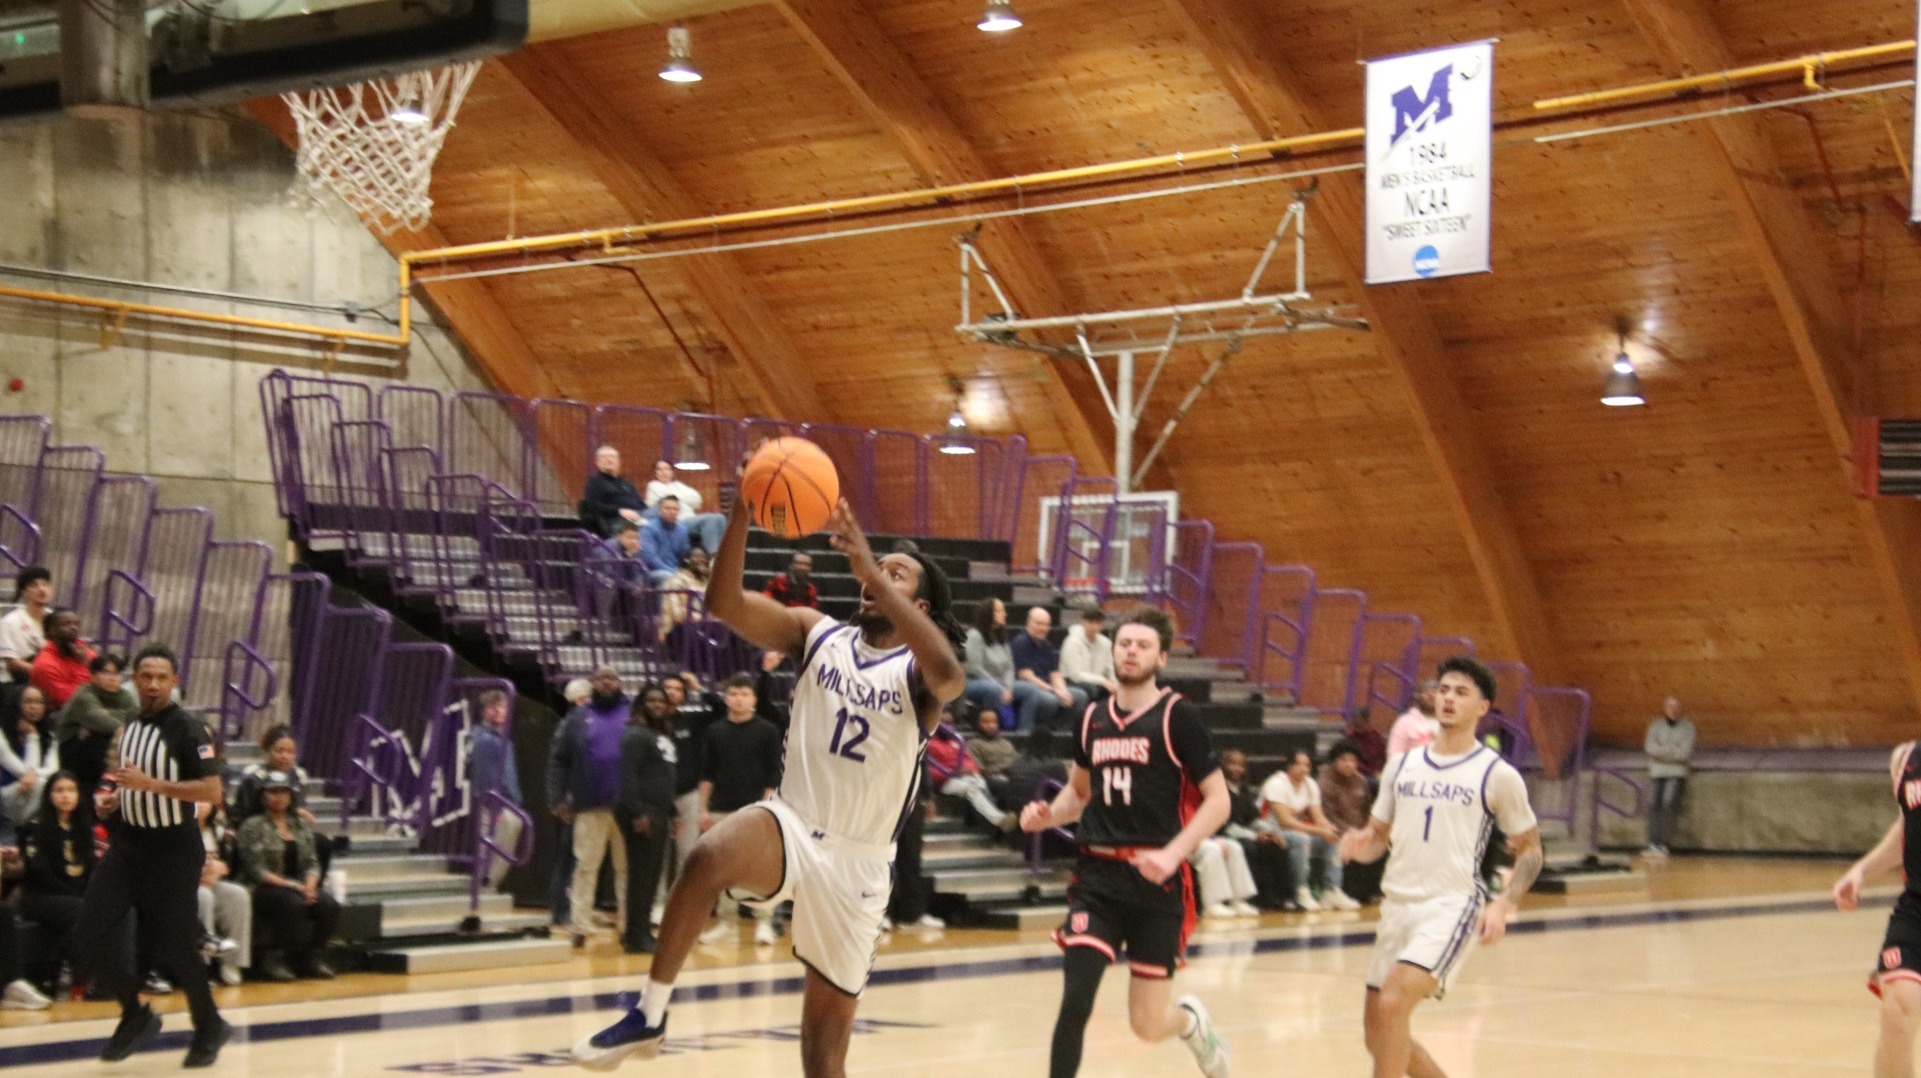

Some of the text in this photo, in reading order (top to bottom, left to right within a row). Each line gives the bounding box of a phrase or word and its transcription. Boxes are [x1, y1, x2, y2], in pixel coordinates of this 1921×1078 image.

[1410, 142, 1447, 165] 1984
[1412, 164, 1475, 185] BASKETBALL
[1405, 187, 1449, 217] NCAA
[816, 663, 903, 714] MILLSAPS
[829, 707, 870, 763] 12
[1092, 736, 1150, 766] RHODES
[1102, 767, 1132, 806] 14
[1397, 780, 1475, 807] MILLSAPS
[1422, 804, 1434, 842] 1
